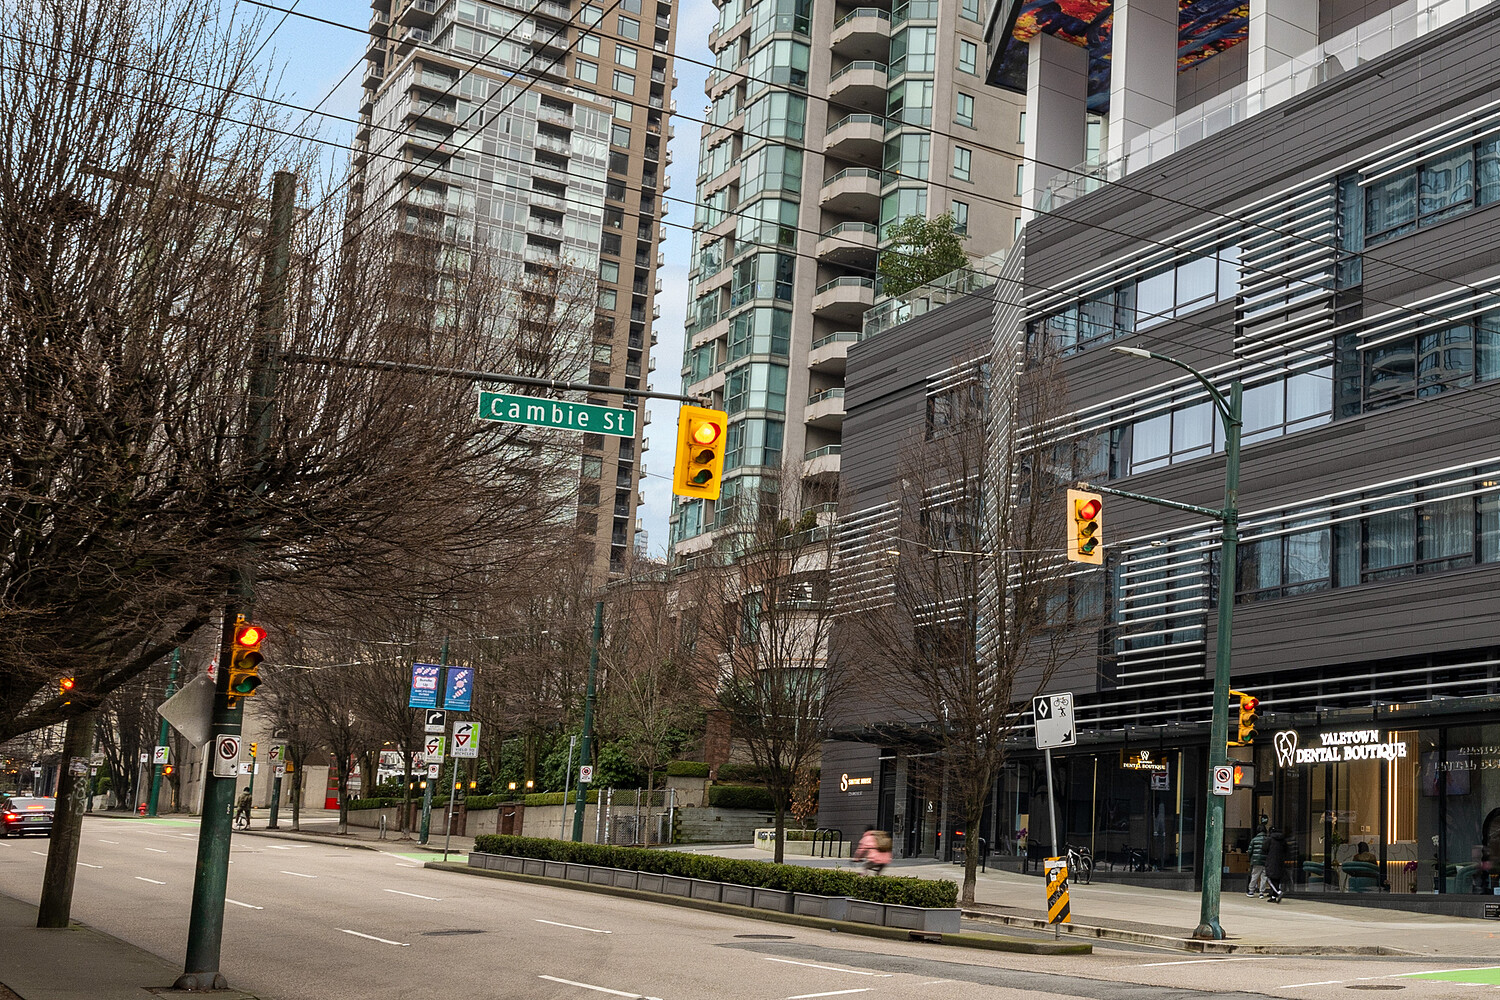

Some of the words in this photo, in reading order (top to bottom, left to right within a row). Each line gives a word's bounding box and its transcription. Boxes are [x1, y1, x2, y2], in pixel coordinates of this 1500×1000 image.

[491, 398, 589, 428] Cambie
[603, 412, 625, 432] St
[1320, 730, 1379, 746] YALETOWN
[1296, 746, 1341, 763] DENTAL
[1344, 742, 1407, 761] BOUTIQUE
